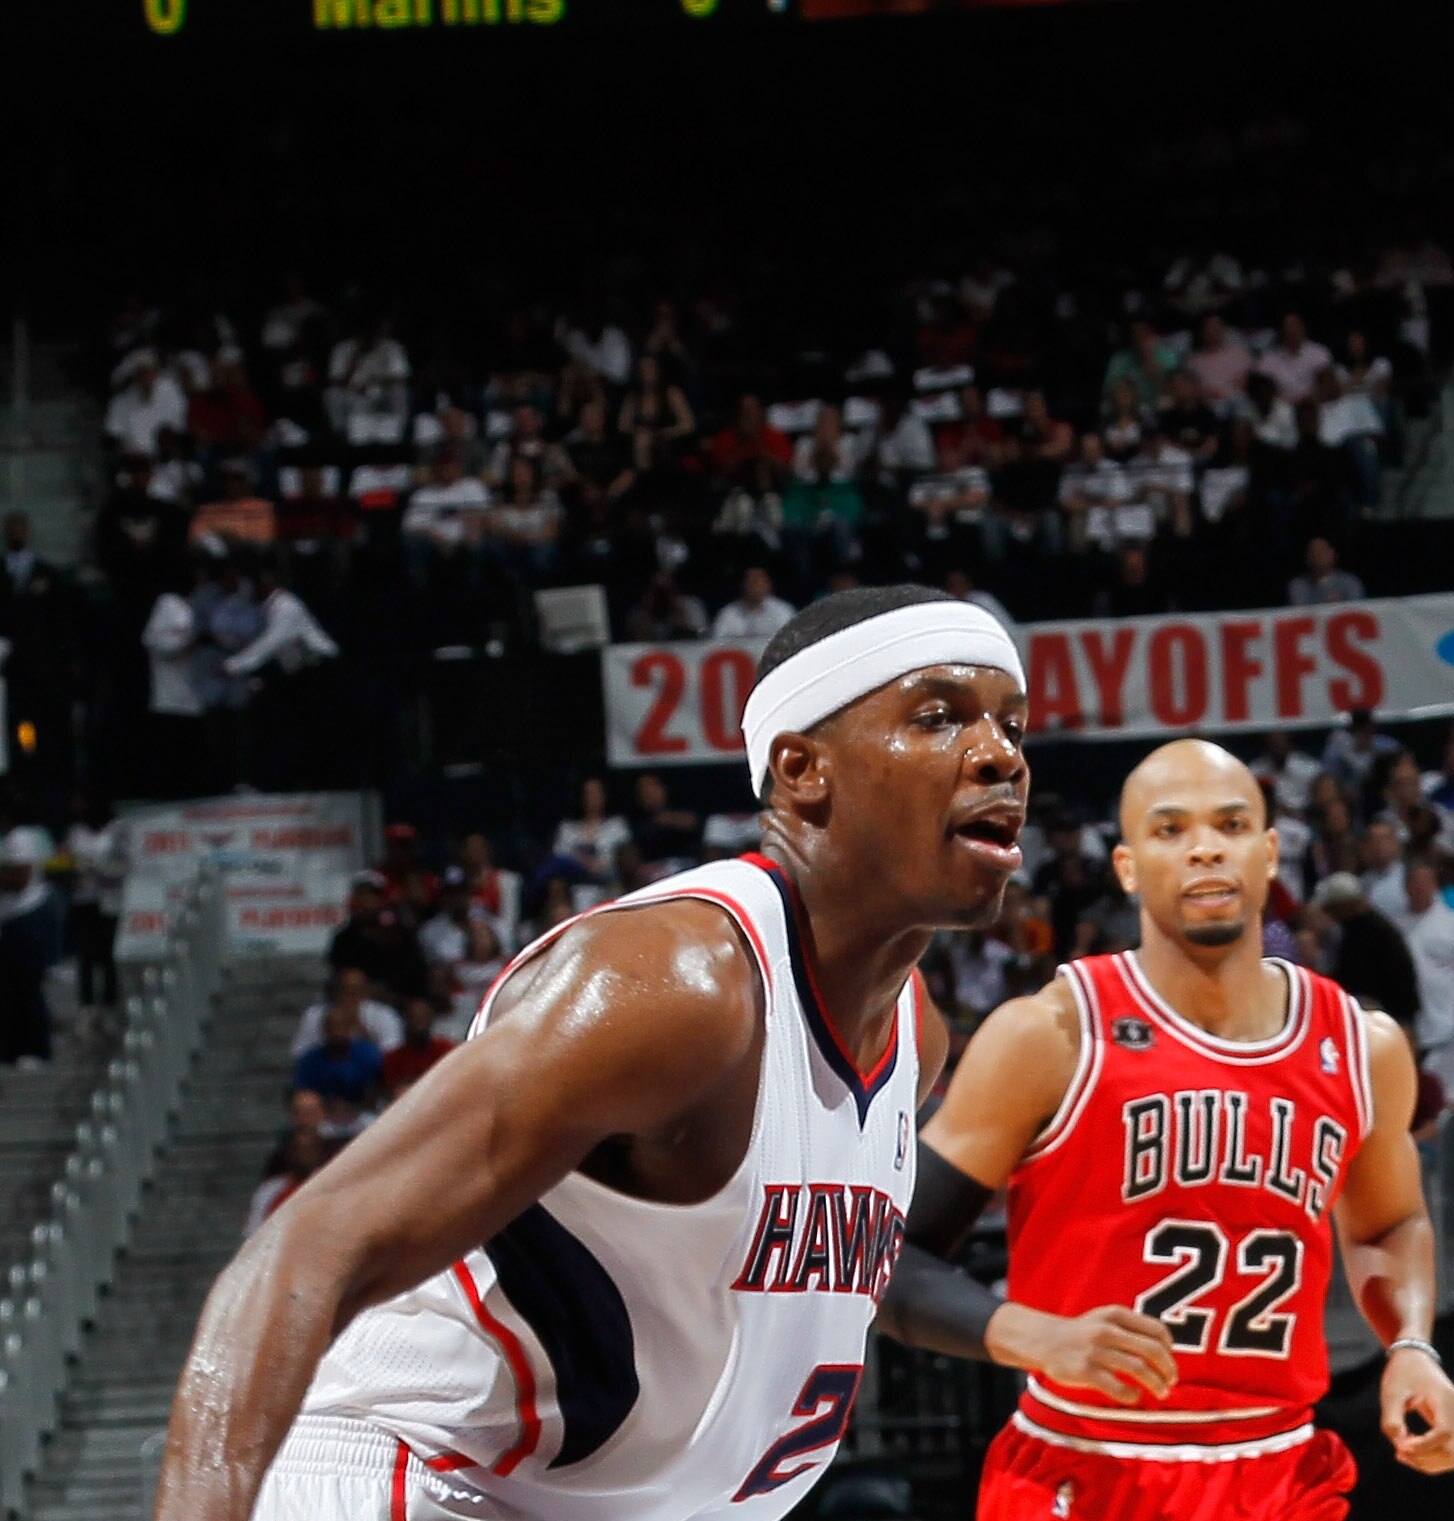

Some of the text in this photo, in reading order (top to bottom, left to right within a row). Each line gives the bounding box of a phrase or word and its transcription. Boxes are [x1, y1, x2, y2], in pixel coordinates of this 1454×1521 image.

[630, 610, 1384, 755] 20 AYOFFS
[1122, 1090, 1347, 1224] BULLS
[1134, 1217, 1304, 1359] 22
[731, 1363, 864, 1503] 2
